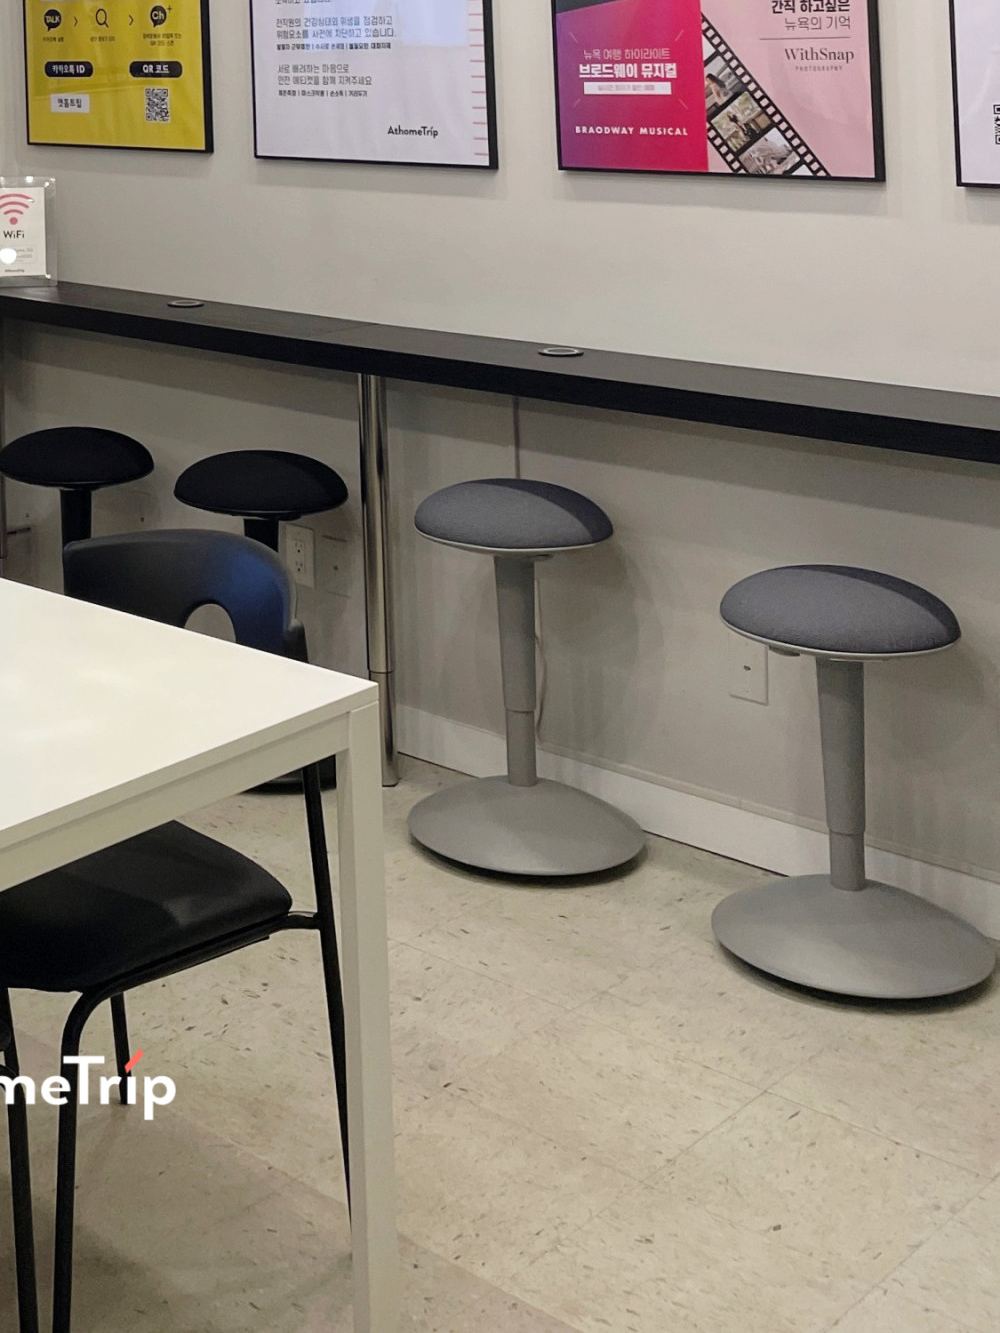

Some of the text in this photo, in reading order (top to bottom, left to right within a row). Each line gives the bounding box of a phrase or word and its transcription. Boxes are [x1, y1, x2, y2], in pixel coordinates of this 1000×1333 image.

[771, 0, 796, 14] 간직
[45, 15, 61, 24] TALK
[363, 15, 393, 26] 점검하고
[784, 15, 851, 31] 뉴욕의 기억
[583, 47, 671, 61] 뉴욕 여행 하이라이트
[784, 47, 855, 64] WithSnap
[51, 64, 86, 74] 카카오톡 ID
[142, 64, 170, 74] QR 코드
[579, 62, 678, 78] 브로드웨이 뮤지컬
[387, 125, 439, 138] AthomeTrip
[575, 126, 688, 136] BRAODWAY MUSICAL
[3, 230, 25, 239] WiFi
